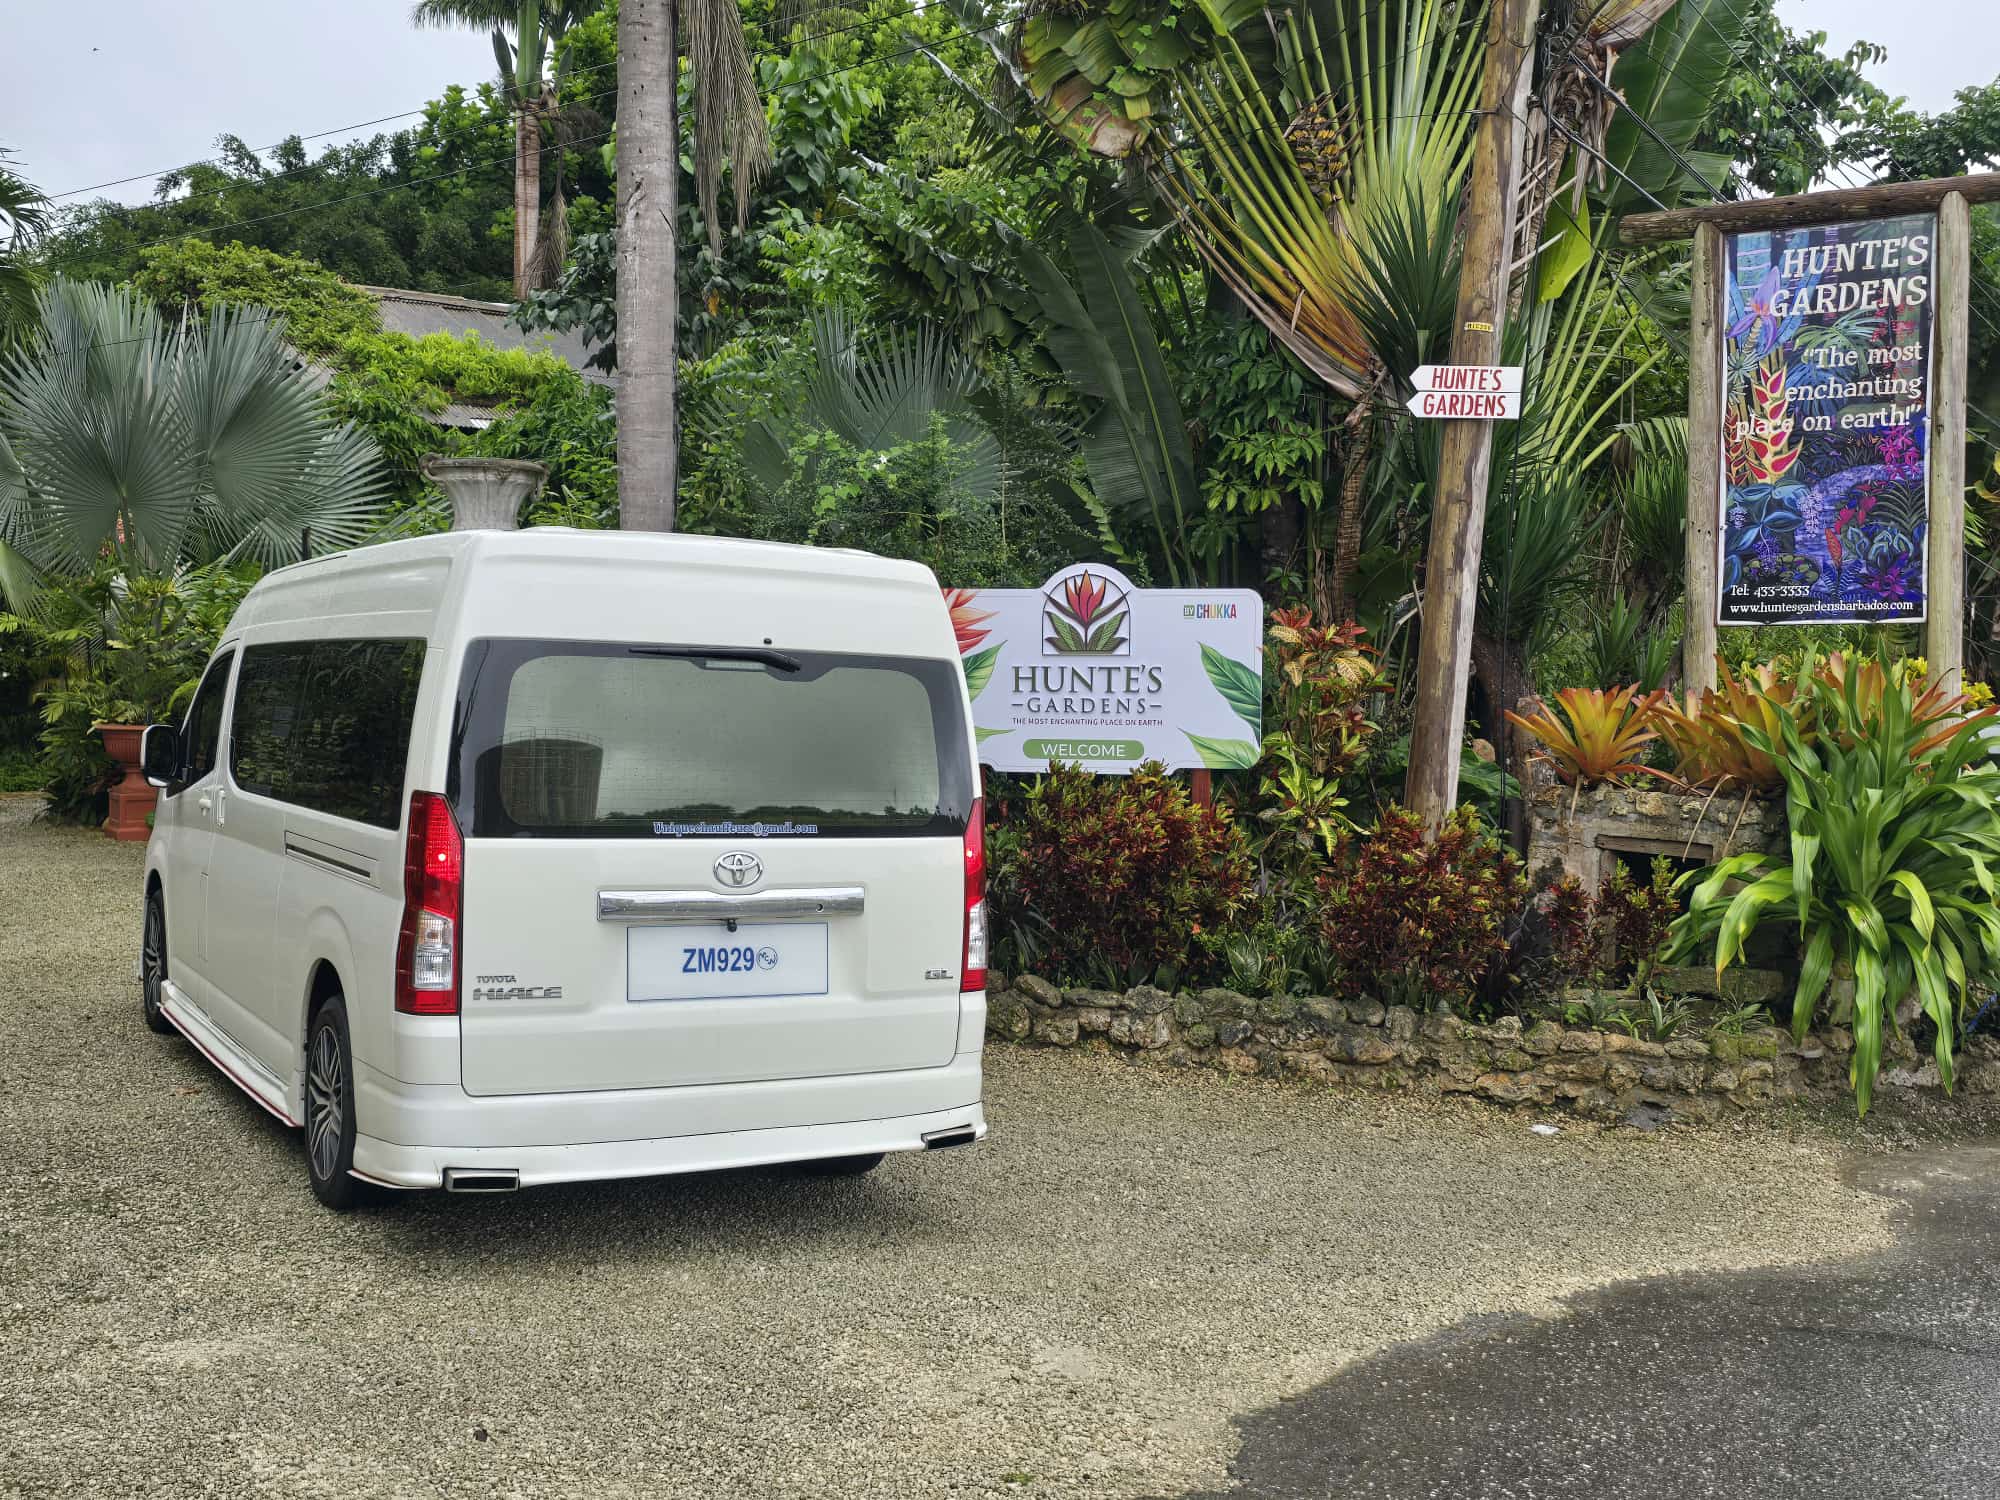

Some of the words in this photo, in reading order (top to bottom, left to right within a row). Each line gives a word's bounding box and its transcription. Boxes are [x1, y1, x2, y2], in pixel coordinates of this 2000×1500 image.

[1780, 235, 1929, 280] HUNTE'S
[1769, 275, 1927, 318] GARDENS
[1867, 341, 1923, 365] most
[1431, 367, 1503, 391] HUNTE'S
[1785, 374, 1923, 402] enchanting
[1423, 393, 1507, 417] GARDENS
[1735, 413, 1793, 442] place
[1802, 415, 1832, 432] on
[1730, 584, 1750, 597] Tel:
[1753, 585, 1810, 598] 433-3333
[1196, 603, 1237, 619] CHUKKA
[1730, 600, 1914, 615] www.huntesgardensbarbados.com
[1011, 664, 1163, 694] HUNTE'S
[1026, 697, 1147, 714] GARDENS
[1012, 717, 1026, 725] THE
[1028, 717, 1048, 726] MOST
[1050, 718, 1098, 726] ENCHANTING
[1125, 719, 1136, 727] ON
[1138, 719, 1163, 727] EARTH
[1041, 743, 1126, 757] WELCOME
[682, 946, 755, 974] ZM929
[476, 975, 517, 984] TOYOTA
[925, 969, 953, 980] GL
[472, 985, 563, 1001] HIACE
